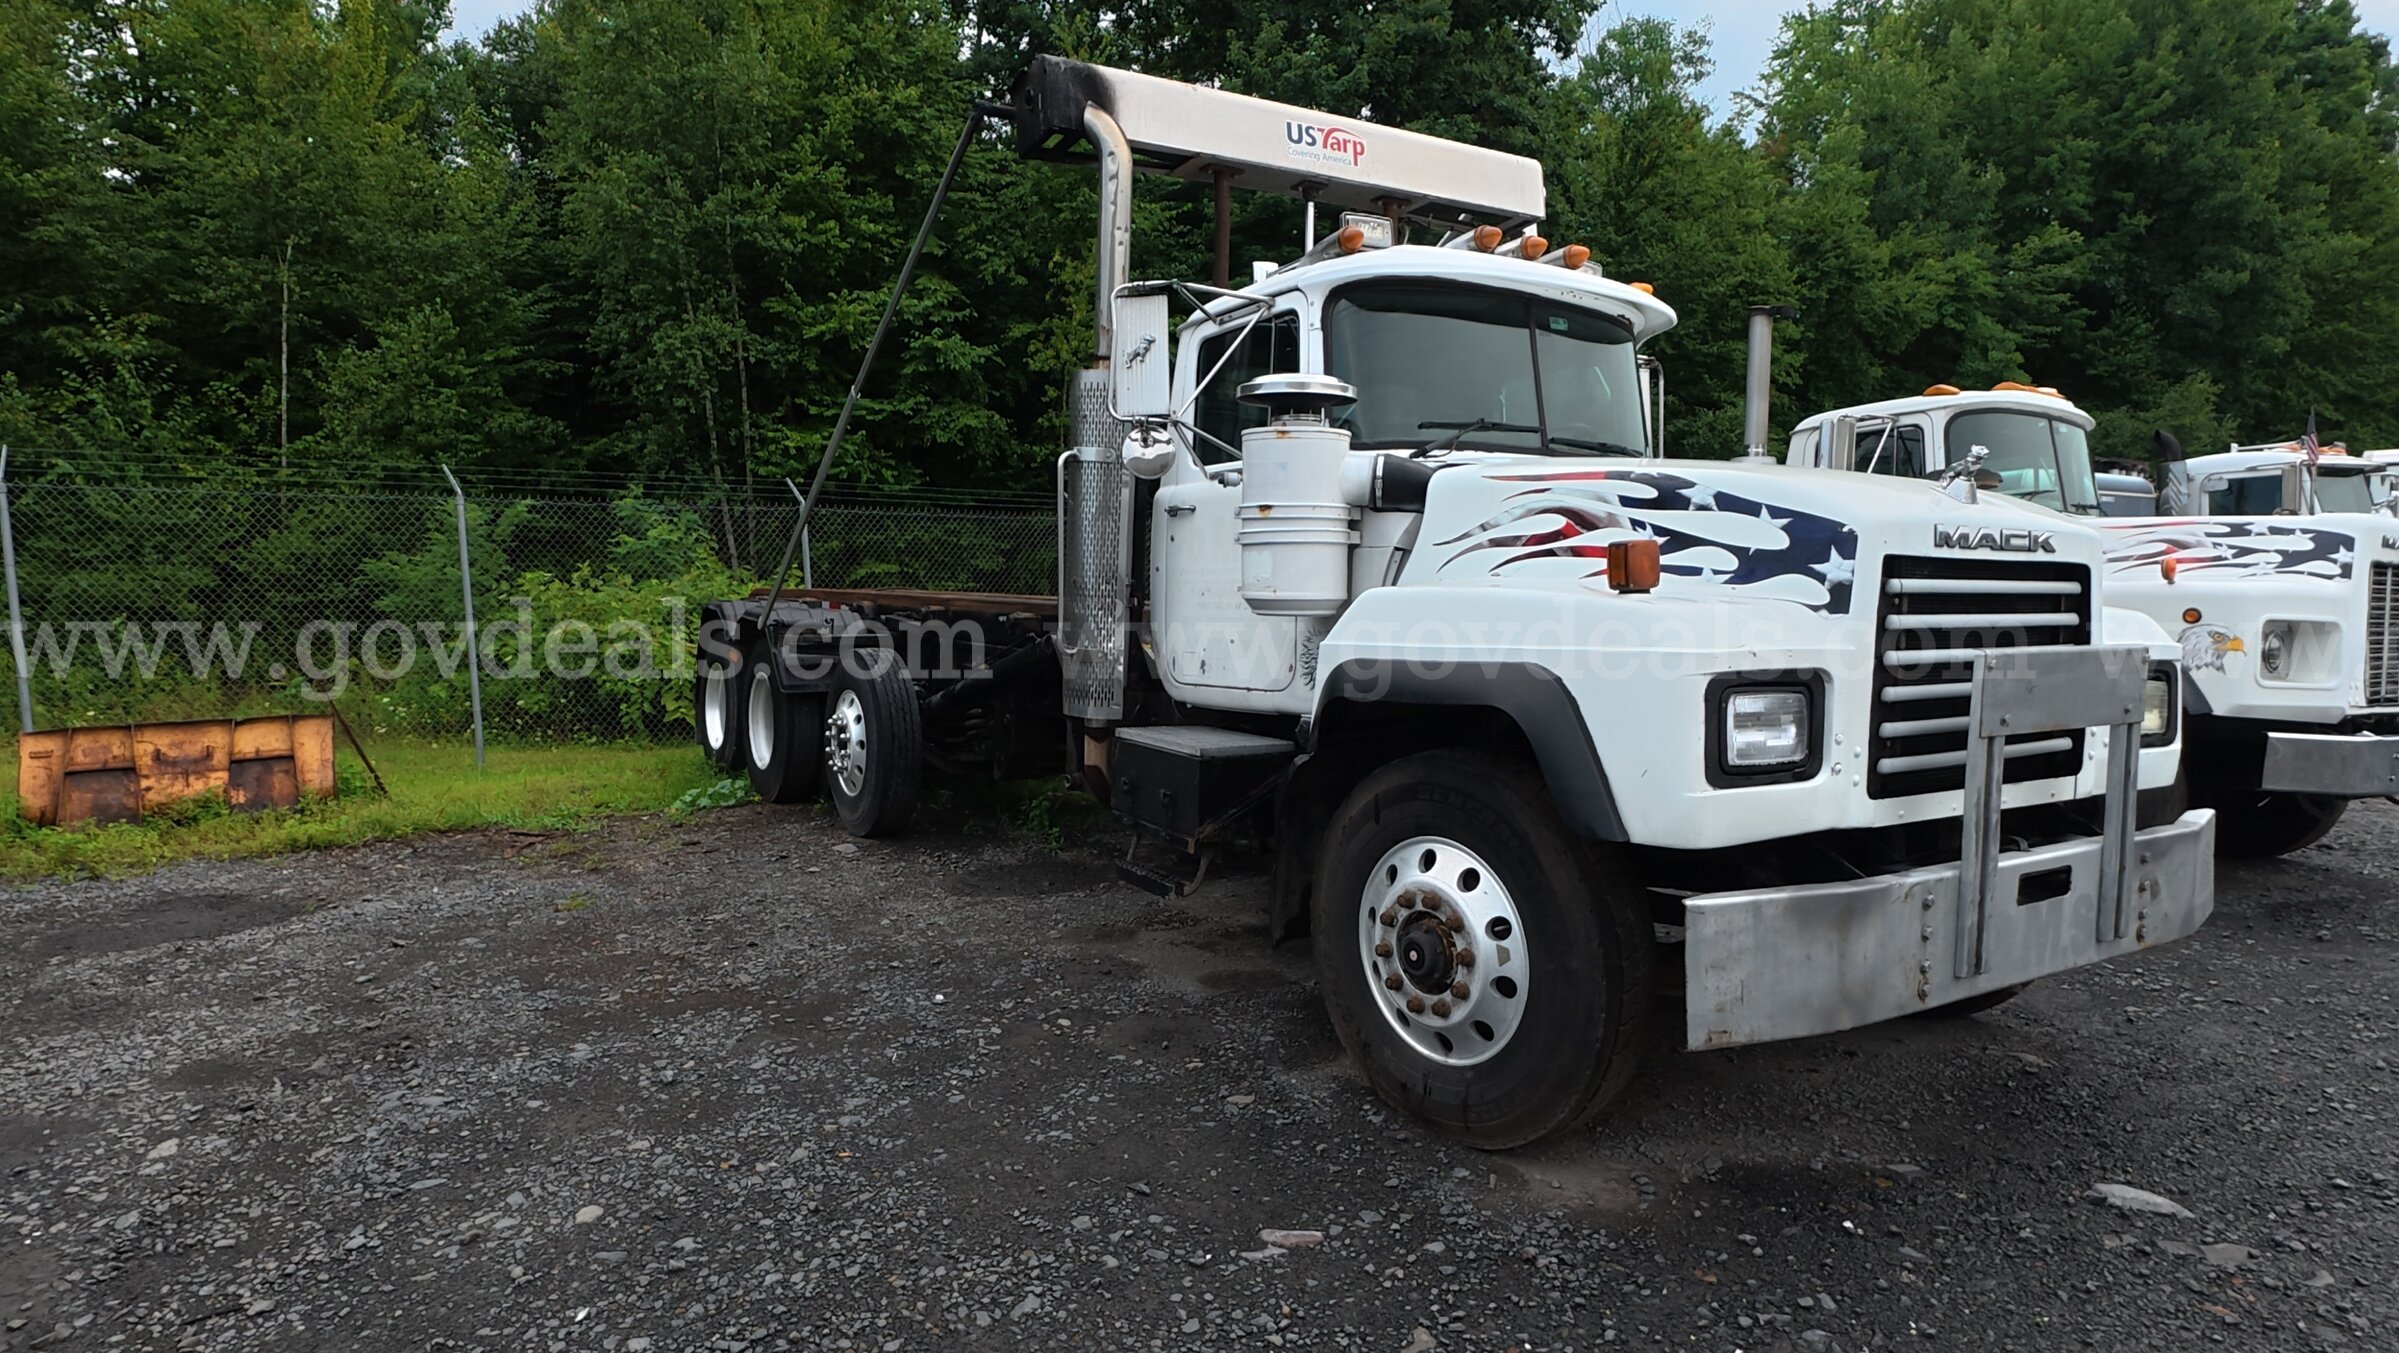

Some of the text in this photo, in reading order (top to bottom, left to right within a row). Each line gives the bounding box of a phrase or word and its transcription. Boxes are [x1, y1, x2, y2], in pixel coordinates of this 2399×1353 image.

[1287, 146, 1352, 166] Covering America
[1933, 523, 2057, 553] MACK
